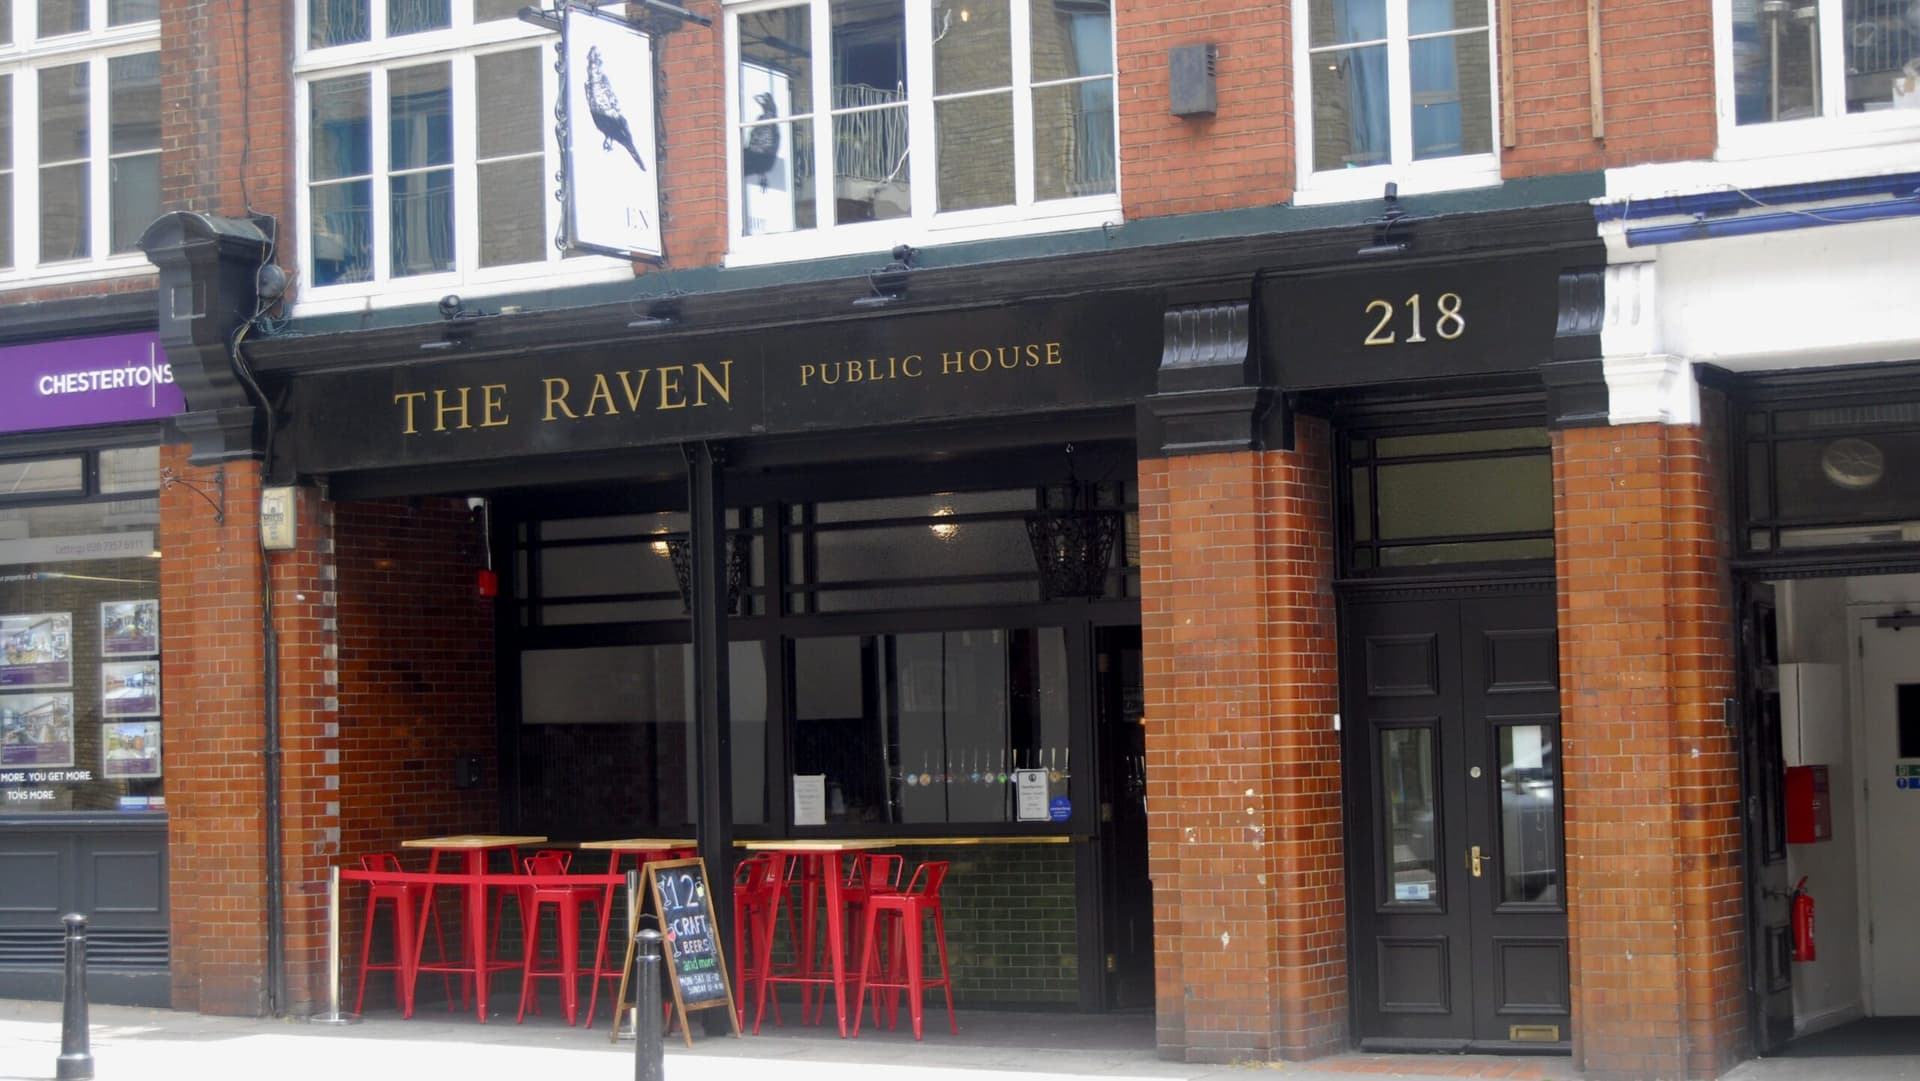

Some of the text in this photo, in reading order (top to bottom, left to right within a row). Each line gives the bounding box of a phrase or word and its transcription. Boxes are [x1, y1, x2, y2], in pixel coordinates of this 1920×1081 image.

[1363, 292, 1465, 345] 218
[39, 363, 175, 395] CHESTERTONS
[800, 342, 1062, 386] PUBLIC HOUSE
[394, 360, 734, 434] THE RAVEN
[29, 772, 45, 781] YOU
[48, 771, 64, 781] GET
[666, 874, 699, 910] 12
[673, 915, 707, 937] CRAFT
[682, 938, 710, 954] BEERS
[682, 958, 698, 971] and
